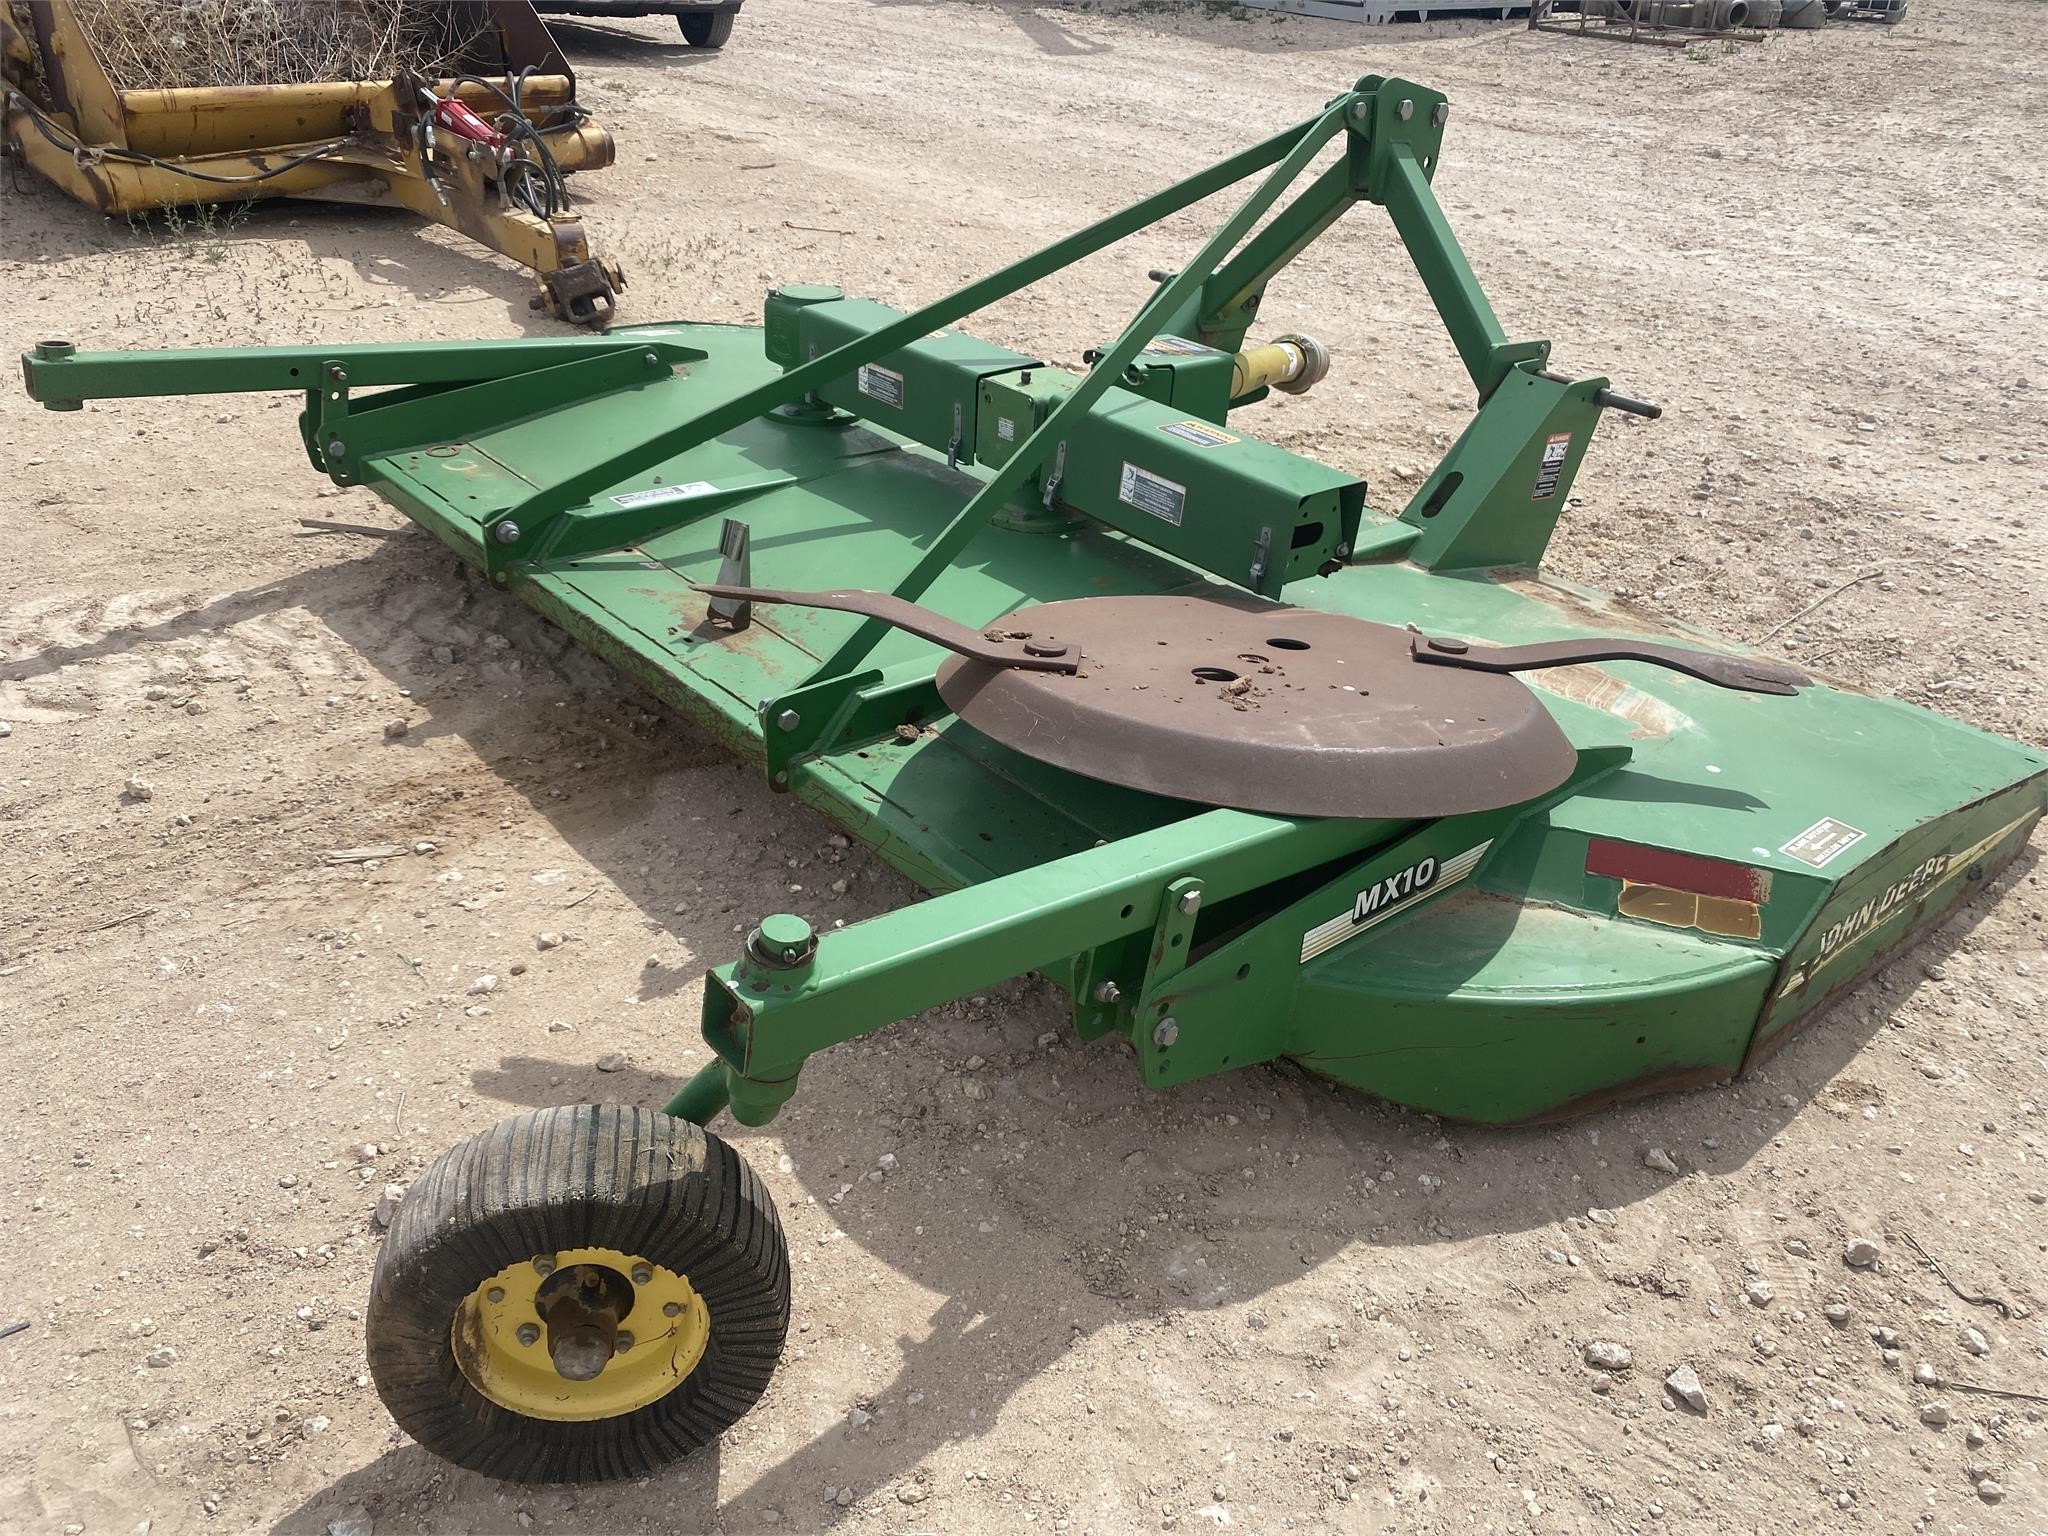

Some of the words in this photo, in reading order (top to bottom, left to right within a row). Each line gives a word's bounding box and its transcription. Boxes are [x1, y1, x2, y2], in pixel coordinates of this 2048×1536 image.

[1352, 857, 1436, 921] MX10
[1813, 896, 1877, 965] JOHN
[1878, 855, 1948, 914] DEERE
